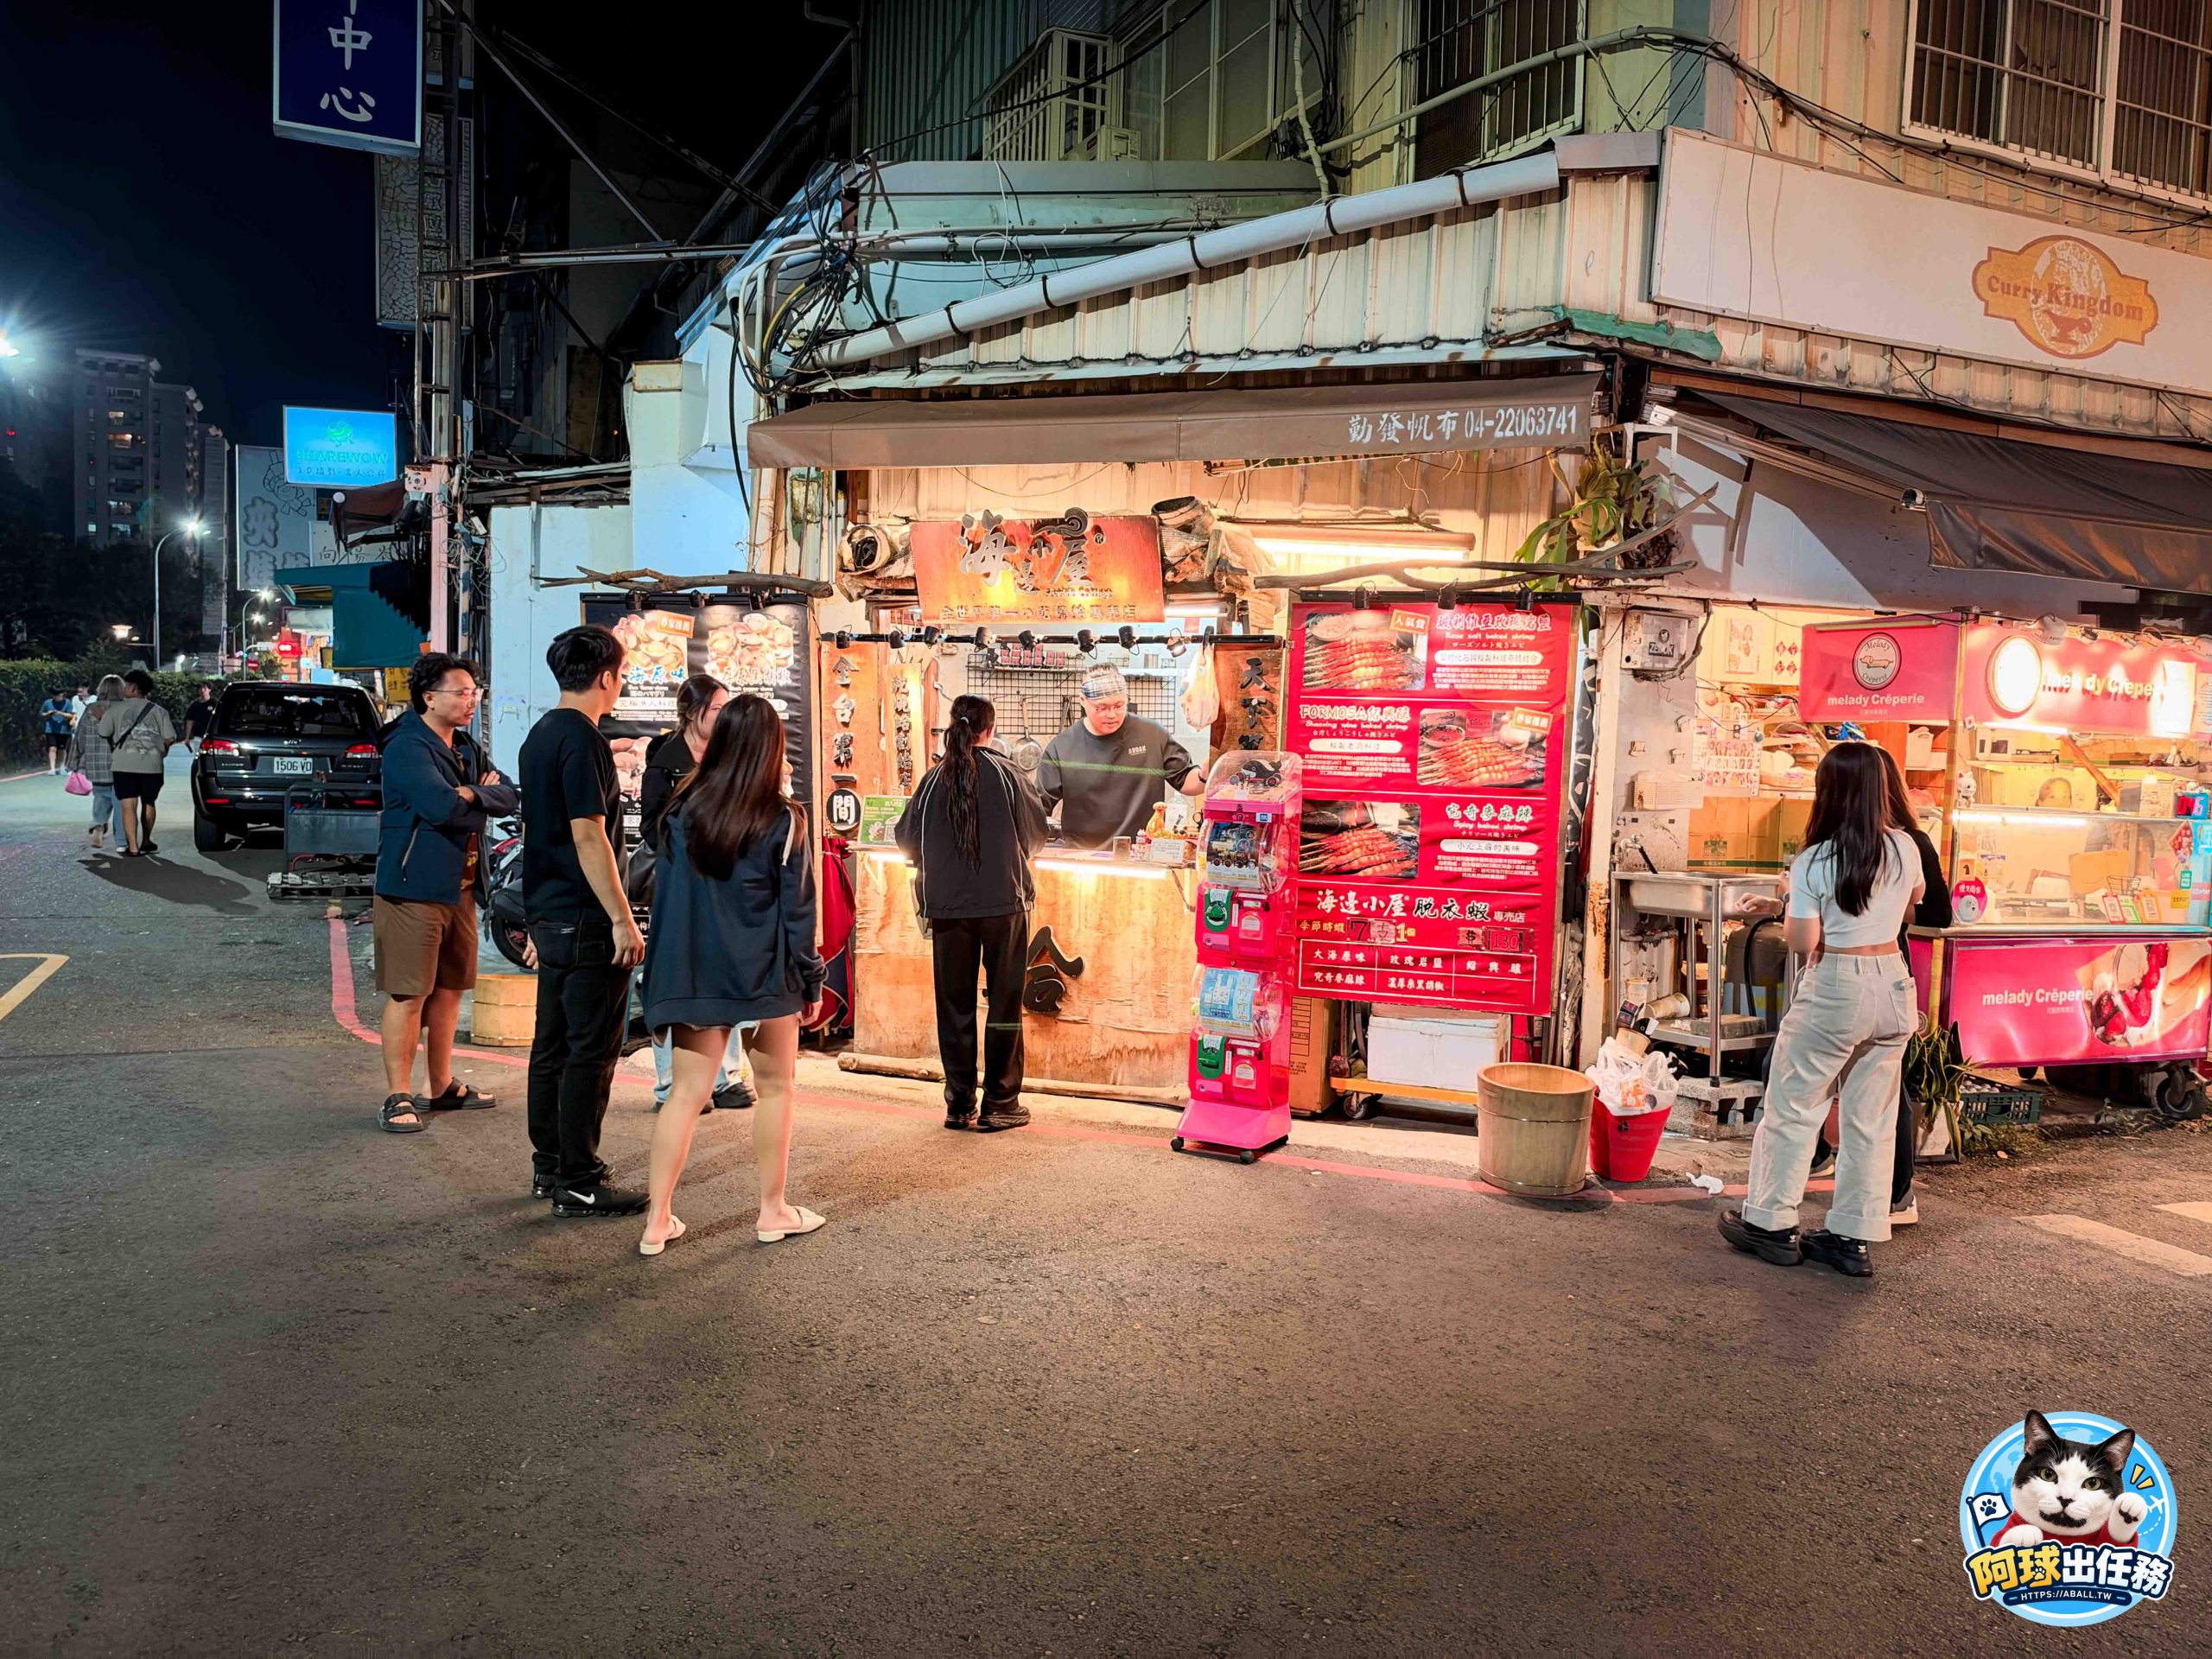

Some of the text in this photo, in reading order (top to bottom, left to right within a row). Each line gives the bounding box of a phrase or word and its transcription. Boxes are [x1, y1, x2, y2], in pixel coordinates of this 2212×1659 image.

[320, 0, 376, 122] 中心
[1987, 274, 2144, 321] Curry Kingdom
[1348, 404, 1578, 444] 勤發帆布 04-22063741
[622, 665, 689, 684] 海原味
[1827, 692, 1925, 708] melady Crêperie
[276, 760, 298, 772] 1506
[1453, 820, 1474, 830] Spicy
[1316, 888, 1407, 918] 海邊小屋
[1313, 949, 1366, 963] 大海原味
[1981, 987, 2094, 1007] melady Crêperie
